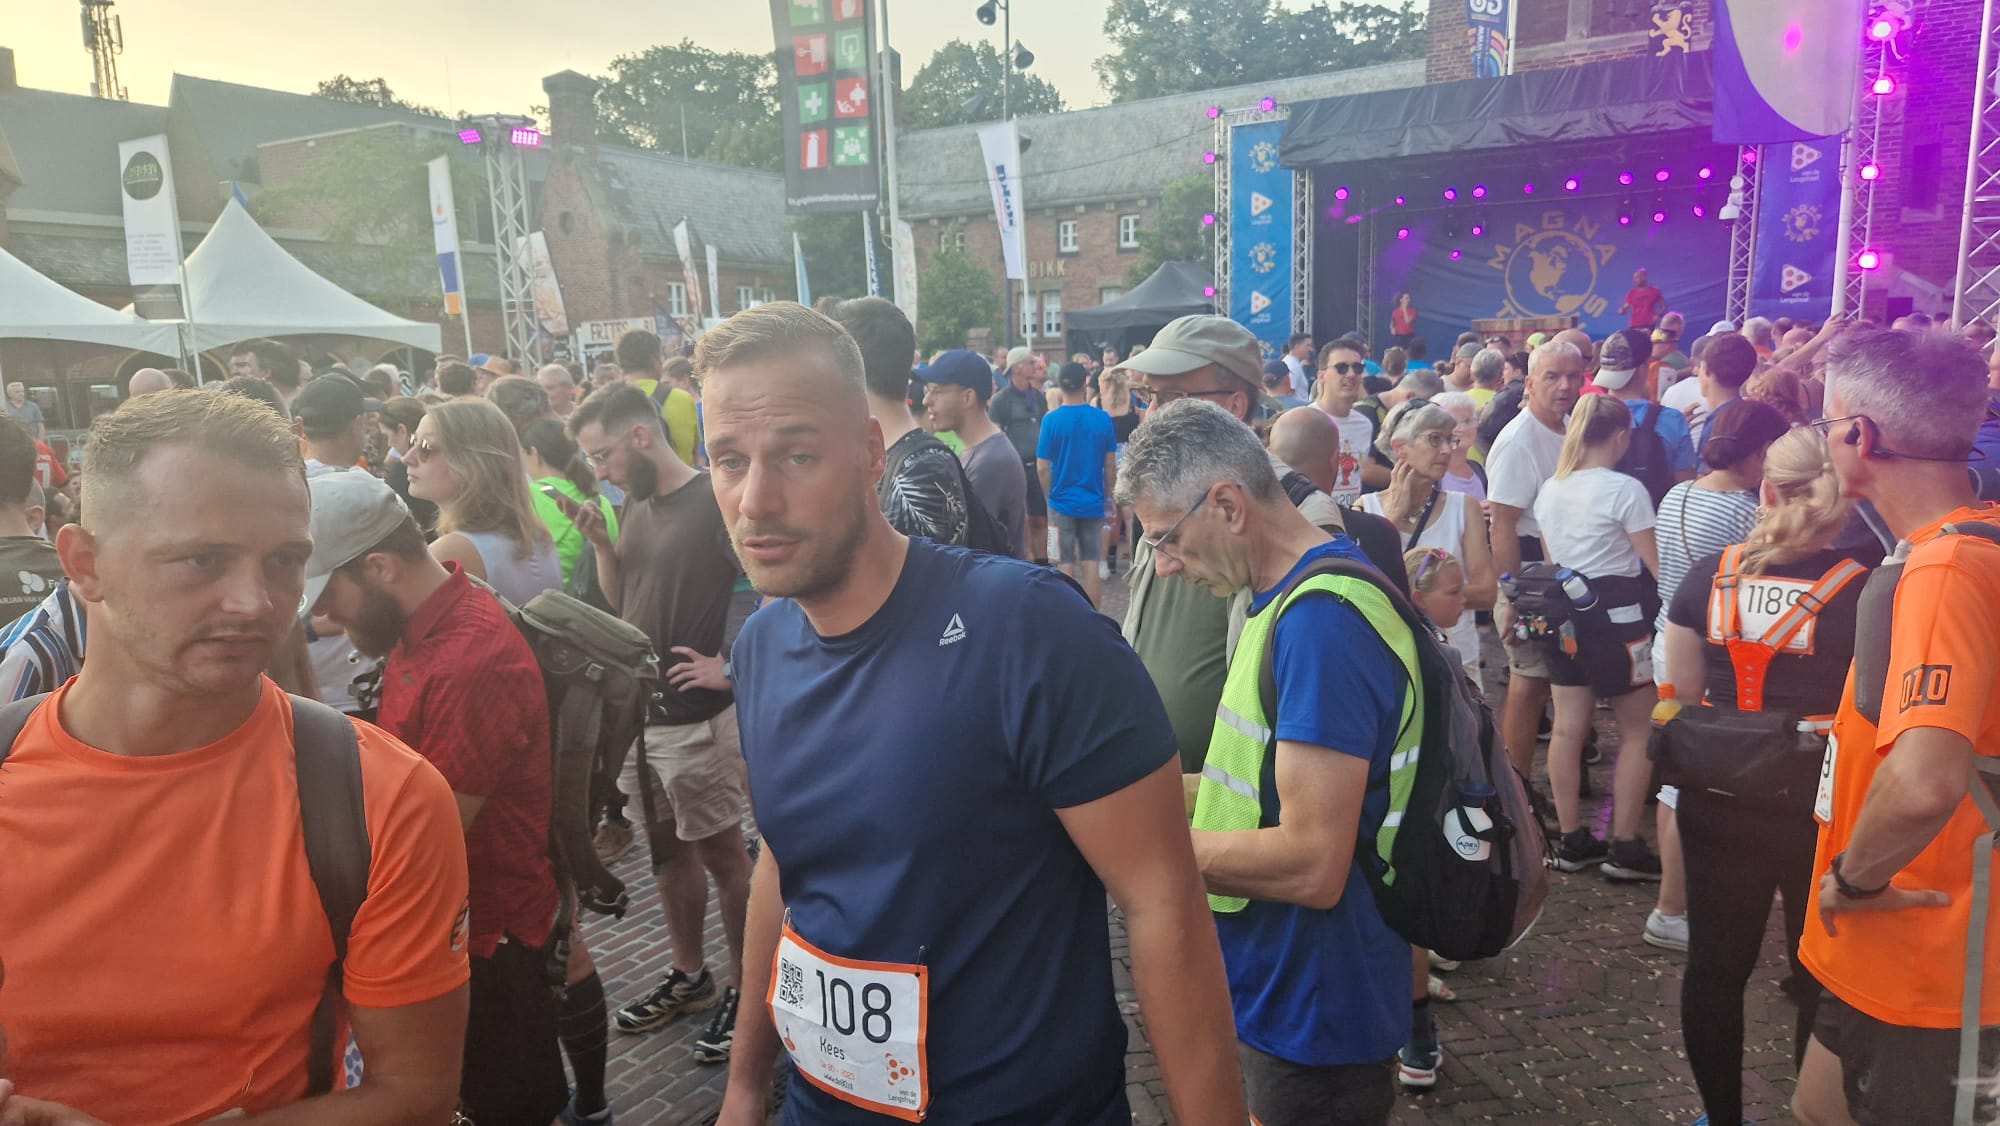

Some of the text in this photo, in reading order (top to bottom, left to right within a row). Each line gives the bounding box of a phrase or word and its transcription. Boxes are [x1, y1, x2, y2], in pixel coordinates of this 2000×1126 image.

[1488, 211, 1617, 270] MAGNA
[938, 631, 967, 647] Reebok
[1900, 668, 1949, 709] 010
[815, 968, 893, 1044] 108
[819, 1035, 846, 1061] Kees
